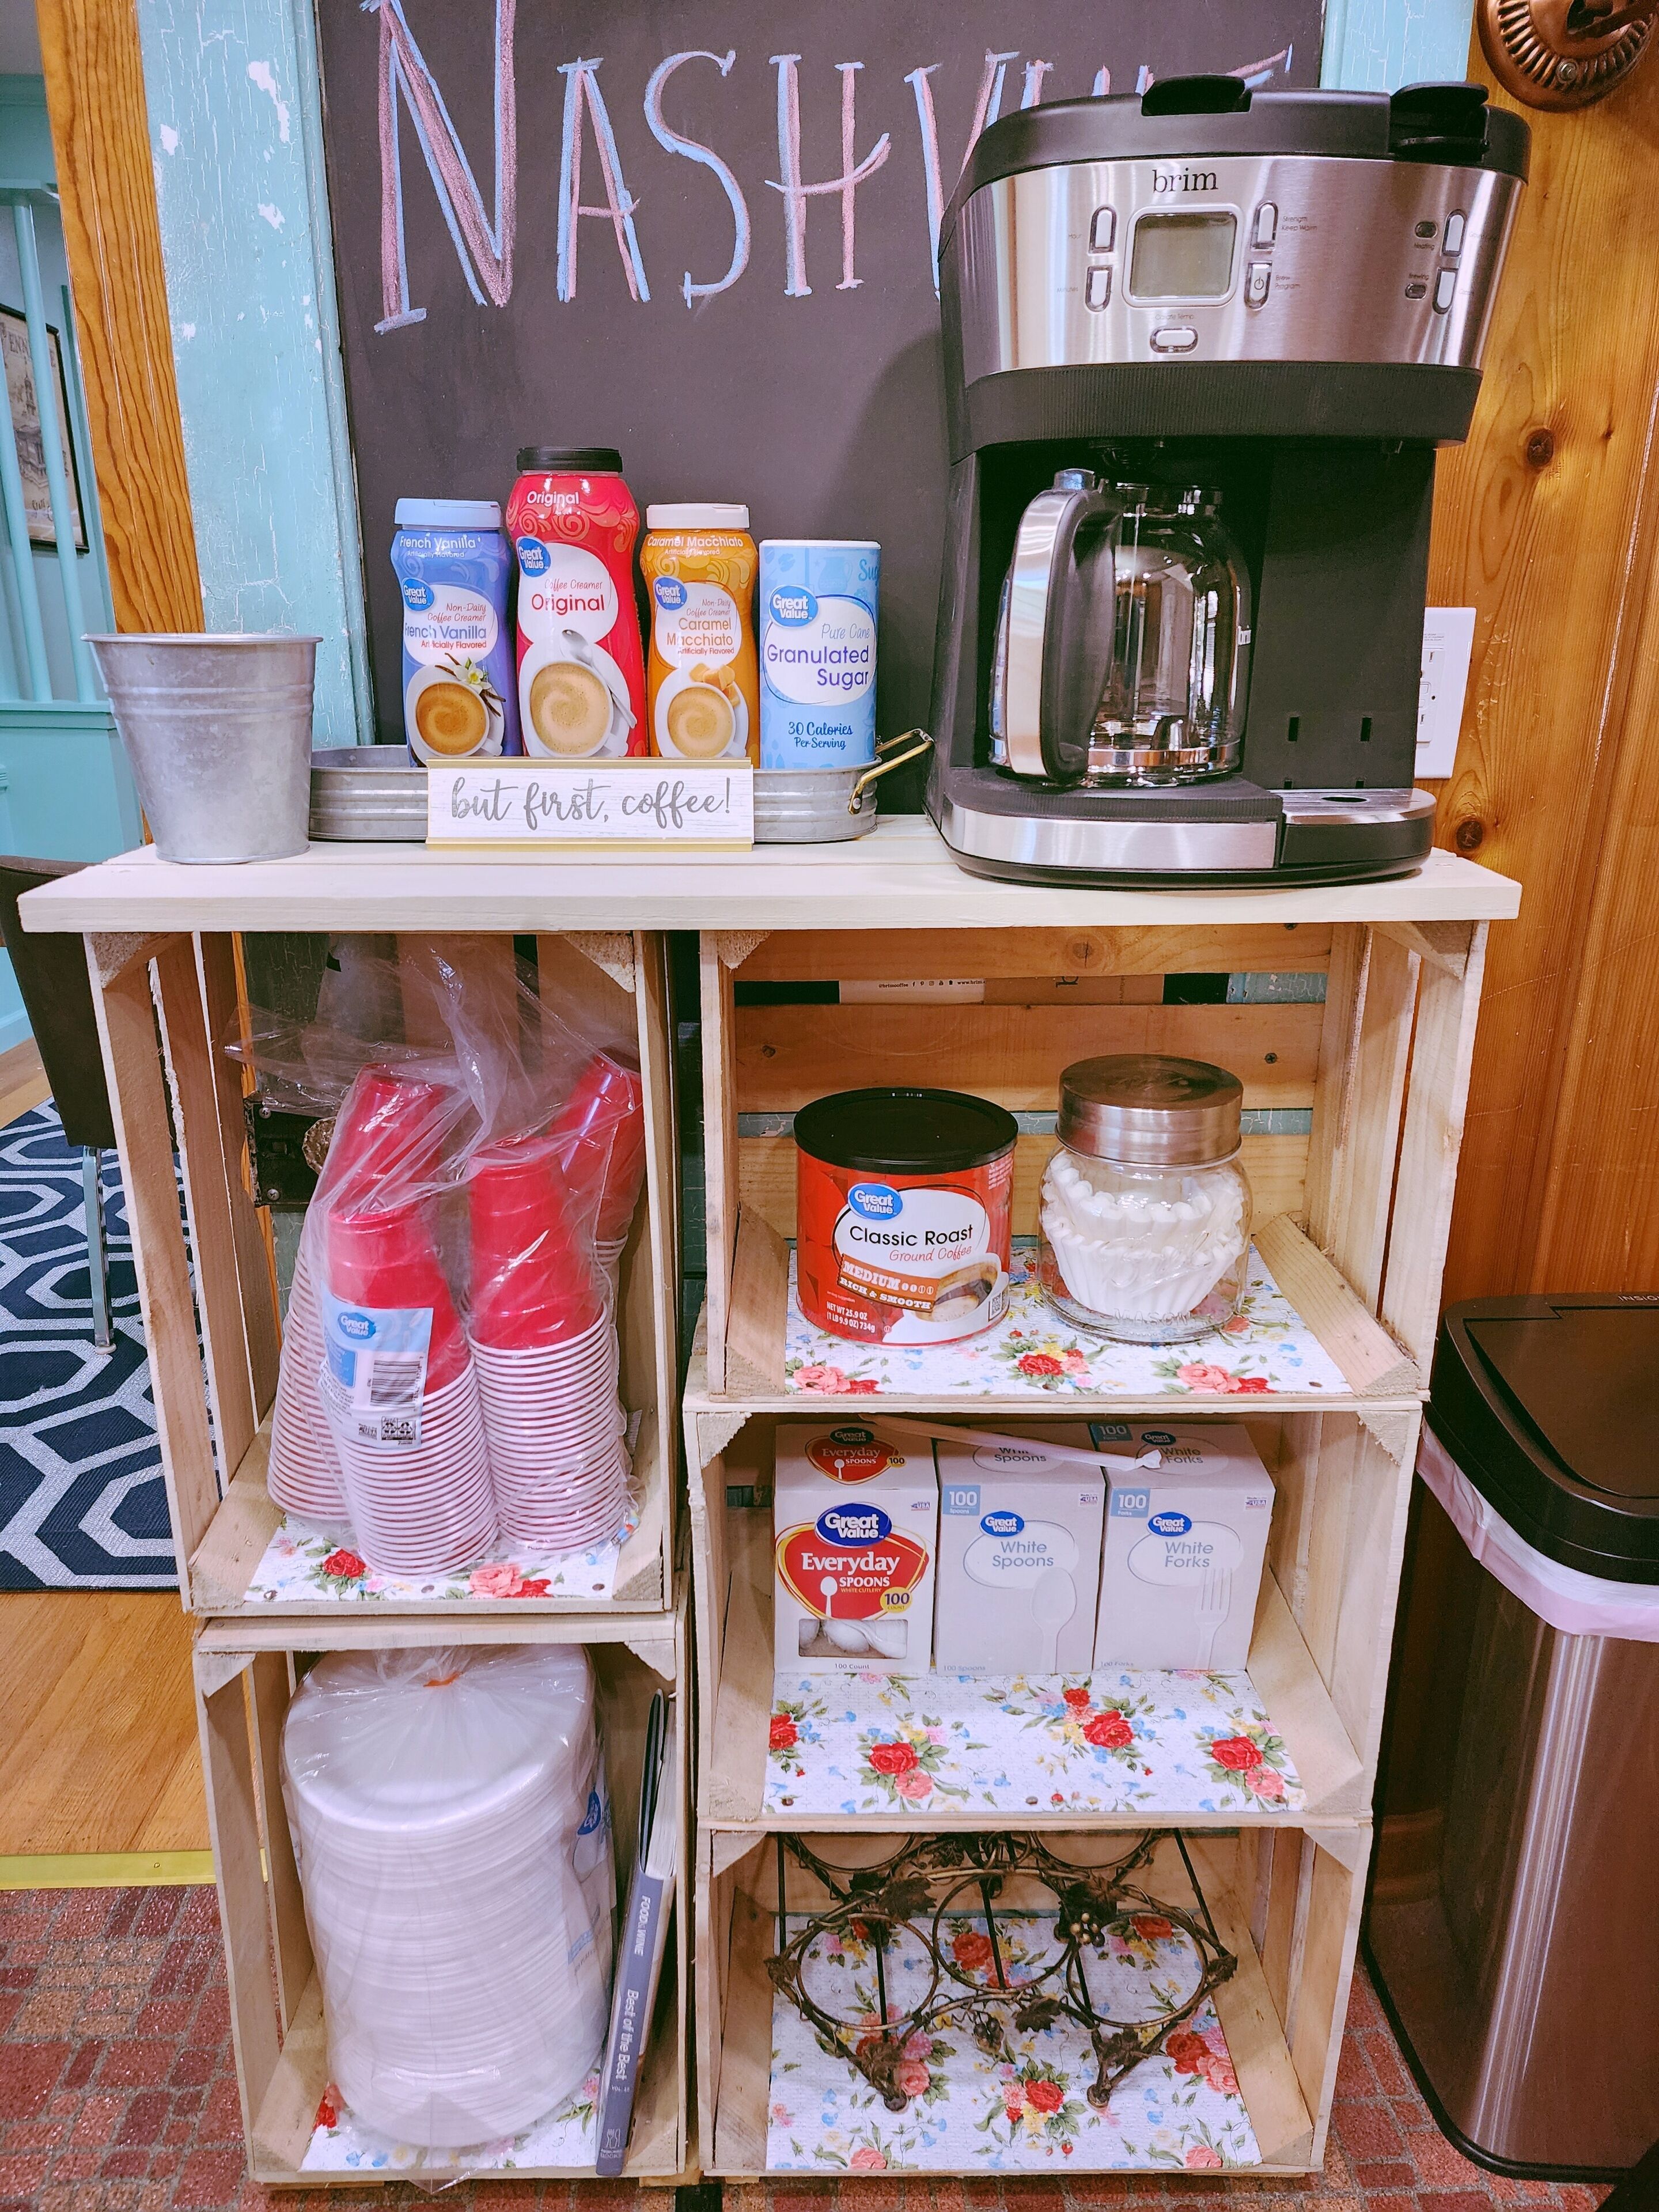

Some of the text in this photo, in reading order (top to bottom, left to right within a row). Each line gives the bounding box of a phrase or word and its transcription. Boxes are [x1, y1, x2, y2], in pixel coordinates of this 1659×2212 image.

[359, 0, 1293, 332] NASHV
[1152, 167, 1219, 194] brim
[527, 491, 579, 507] Original
[400, 535, 476, 550] French Vanilla
[647, 536, 744, 547] Caramel Macchiato
[519, 546, 543, 560] Great
[524, 559, 544, 569] Value
[858, 559, 879, 586] Sug
[403, 585, 426, 598] Great
[545, 578, 603, 592] Coffee Creamer
[656, 584, 680, 597] Great
[408, 596, 427, 604] Value
[532, 594, 605, 615] Original
[663, 595, 681, 604] Value
[773, 594, 809, 610] Great
[446, 603, 486, 614] Non-Dairy
[687, 608, 706, 618] Coffee
[780, 608, 808, 619] Value
[428, 613, 486, 623] Coffee Creamer
[679, 617, 732, 631] Caramel
[440, 625, 487, 639] Vanilla
[822, 623, 870, 639] Pure Cane
[456, 641, 487, 649] Flavored
[767, 643, 869, 664] Granulated
[817, 668, 869, 691] Sugar
[788, 721, 854, 736] 30 Calories
[794, 737, 846, 751] Per Serving
[452, 777, 731, 831] but first, coffee!
[854, 1190, 894, 1207] Great
[864, 1204, 893, 1214] Value
[850, 1224, 973, 1247] Classic Roast
[889, 1244, 972, 1262] Ground Coffee
[842, 1260, 902, 1291] MEDIUM
[839, 1277, 932, 1309] RICH & SMOOTH
[827, 1301, 868, 1321] NET WT 25.9 OZ
[339, 1315, 369, 1330] Great
[832, 1313, 839, 1323] LB
[839, 1316, 849, 1325] 9.9
[849, 1319, 859, 1330] OZ)
[859, 1321, 876, 1334] 734g
[346, 1327, 369, 1336] Value
[1099, 1425, 1127, 1435] 100
[822, 1448, 881, 1459] Everyday
[1161, 1446, 1202, 1456] White
[995, 1455, 1047, 1464] Spoons
[949, 1491, 978, 1506] 100
[1119, 1494, 1147, 1509] 100
[825, 1512, 879, 1530] Great
[985, 1516, 1017, 1528] Great
[1153, 1517, 1185, 1528] Great
[838, 1528, 878, 1539] Value
[1000, 1541, 1047, 1554] White
[1165, 1541, 1214, 1554] White
[801, 1551, 900, 1575] Everyday
[992, 1555, 1054, 1570] Spoons
[1165, 1555, 1210, 1567] Forks
[839, 1576, 890, 1588] SPOONS
[884, 1592, 910, 1605] 100
[616, 1988, 639, 2081] Best of the Best
